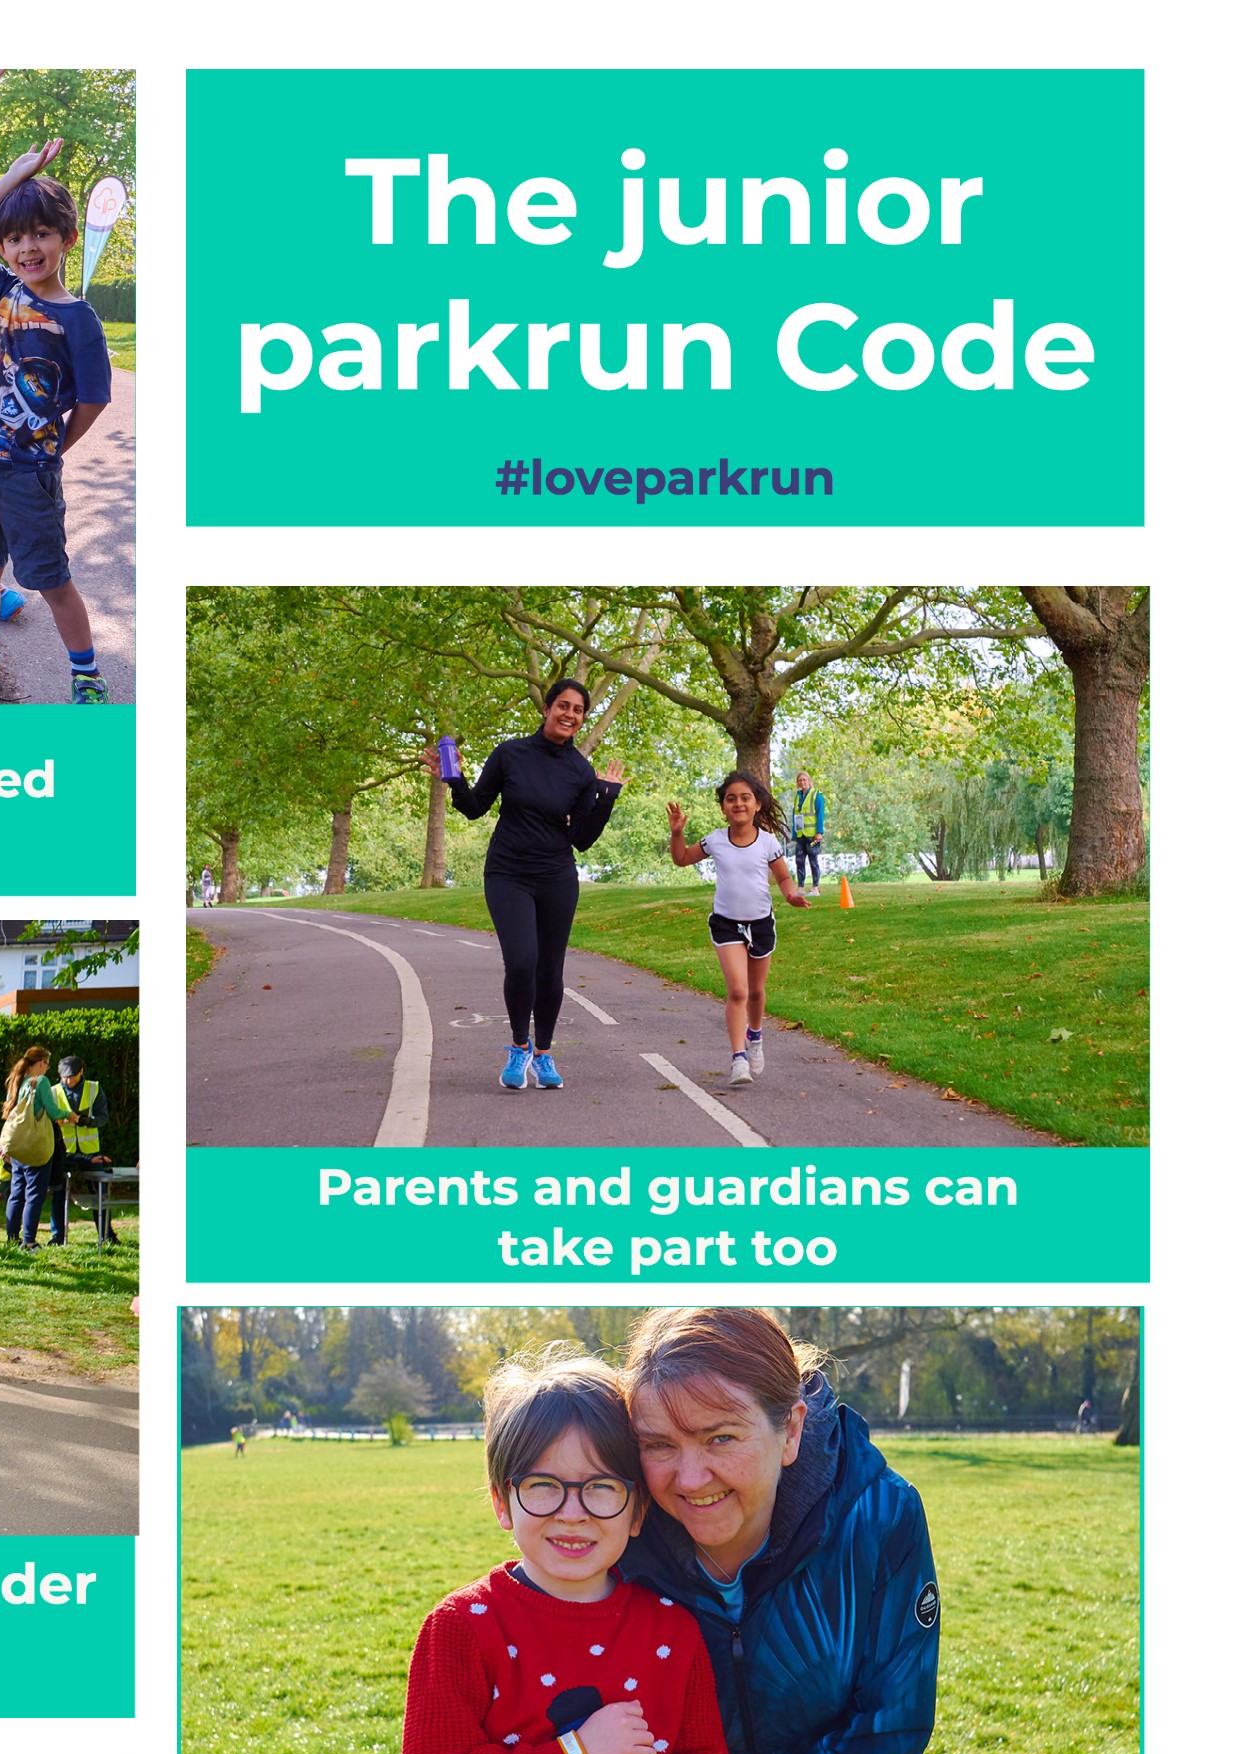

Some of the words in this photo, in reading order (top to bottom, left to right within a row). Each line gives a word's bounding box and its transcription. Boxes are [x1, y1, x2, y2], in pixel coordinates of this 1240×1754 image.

[345, 153, 577, 245] The
[603, 148, 983, 269] junior
[241, 299, 731, 414] parkrun
[777, 299, 1095, 391] Code
[496, 458, 832, 504] #loveparkrun
[320, 1168, 518, 1206] Parents
[534, 1166, 630, 1206] and
[648, 1164, 910, 1215] guardians
[925, 1176, 1017, 1206] can
[497, 1227, 613, 1266] take
[631, 1231, 737, 1275] part
[751, 1231, 837, 1266] too
